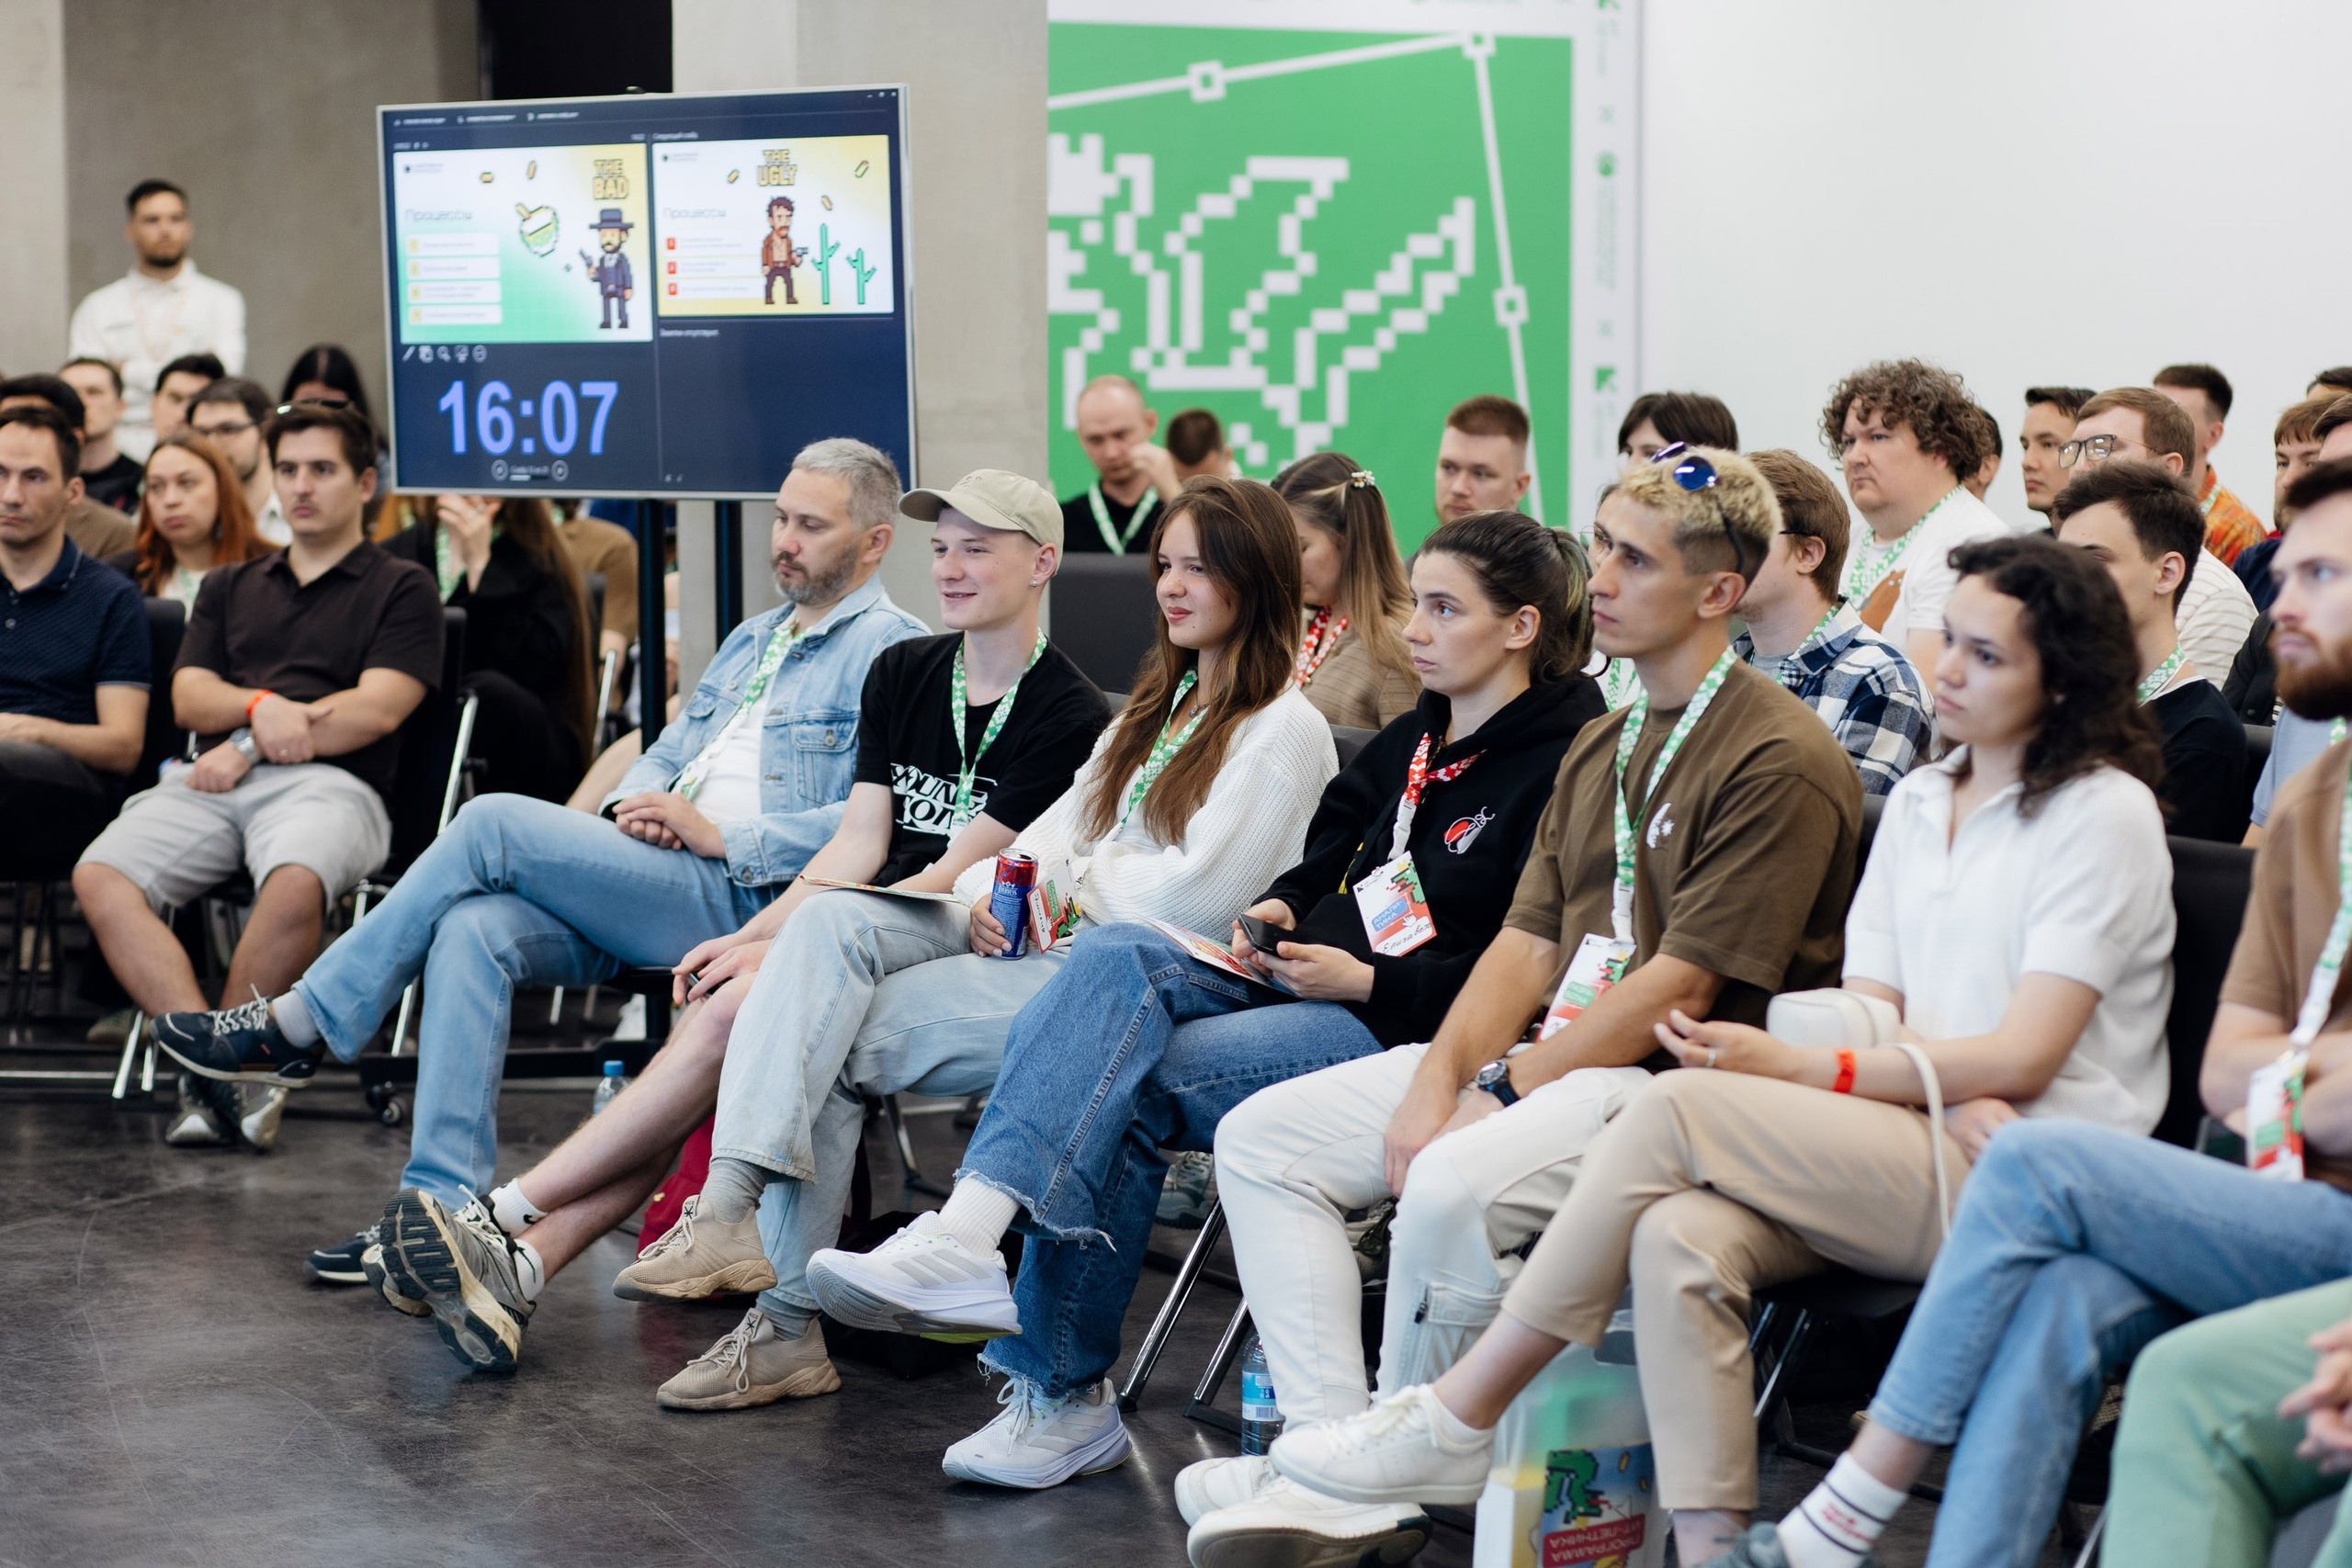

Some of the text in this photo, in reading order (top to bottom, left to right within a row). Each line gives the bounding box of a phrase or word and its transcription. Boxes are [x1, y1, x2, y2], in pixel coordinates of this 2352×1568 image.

[593, 159, 624, 176] THE
[763, 149, 790, 164] THE
[757, 164, 798, 186] UGLY
[593, 175, 629, 200] BAD
[438, 379, 619, 456] 16:07
[1373, 900, 1404, 925] АНАЛИ-
[1375, 912, 1397, 929] ТИКА
